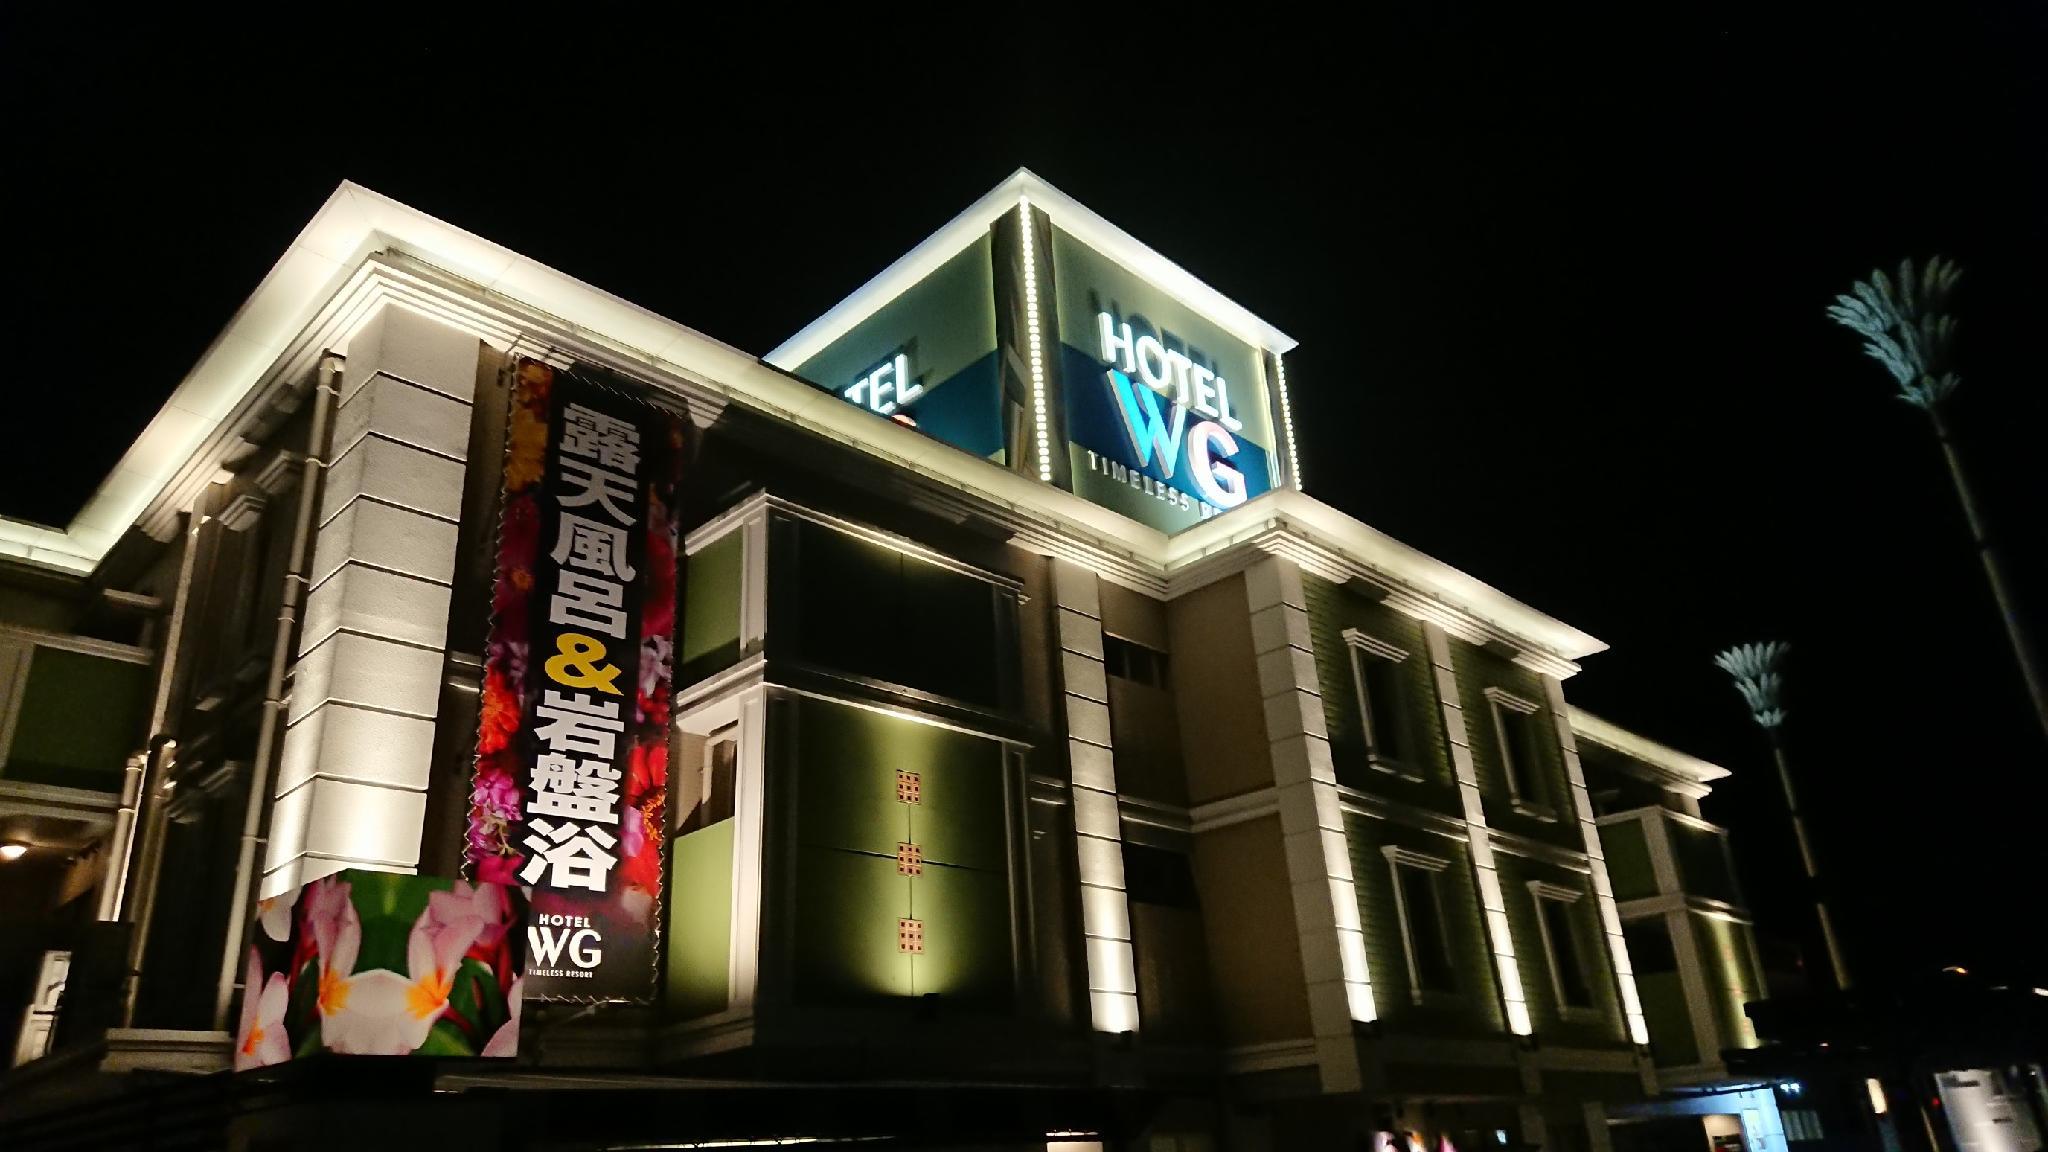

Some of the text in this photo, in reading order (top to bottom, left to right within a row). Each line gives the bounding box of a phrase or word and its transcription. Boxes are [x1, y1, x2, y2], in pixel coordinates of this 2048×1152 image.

[844, 353, 924, 415] TEL
[1098, 312, 1243, 432] HOTEL
[1107, 368, 1247, 510] WG
[1087, 449, 1190, 512] TIMELESS
[519, 402, 641, 893] 露天風呂&岩盤浴
[527, 926, 602, 969] WG
[538, 913, 591, 928] HOTEL
[528, 968, 593, 979] TIMELESS RESORT
